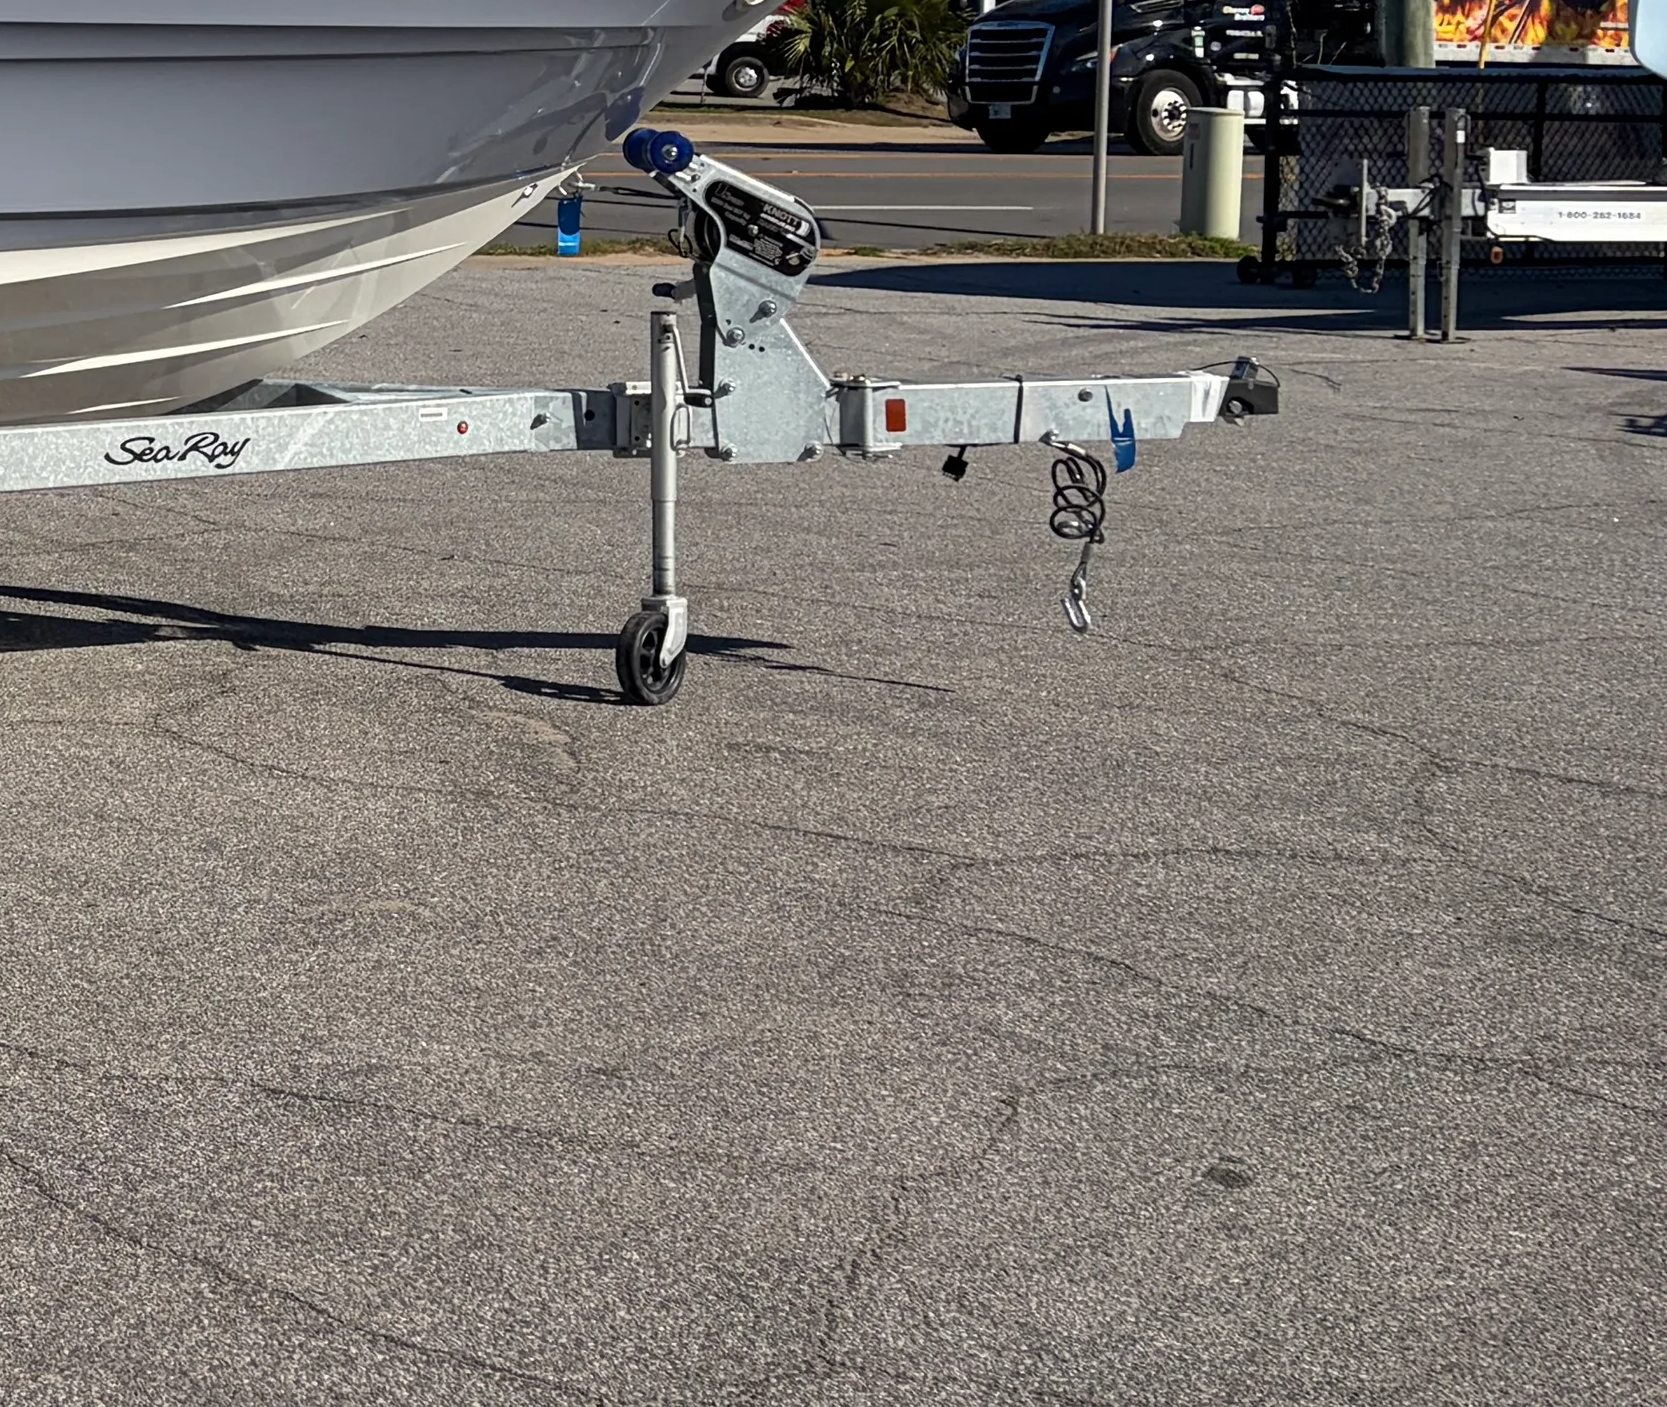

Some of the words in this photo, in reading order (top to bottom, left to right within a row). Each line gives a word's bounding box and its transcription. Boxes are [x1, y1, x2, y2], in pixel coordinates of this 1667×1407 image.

[762, 204, 799, 226] KNOTT
[104, 436, 179, 466] Sea
[177, 432, 251, 470] Ray
